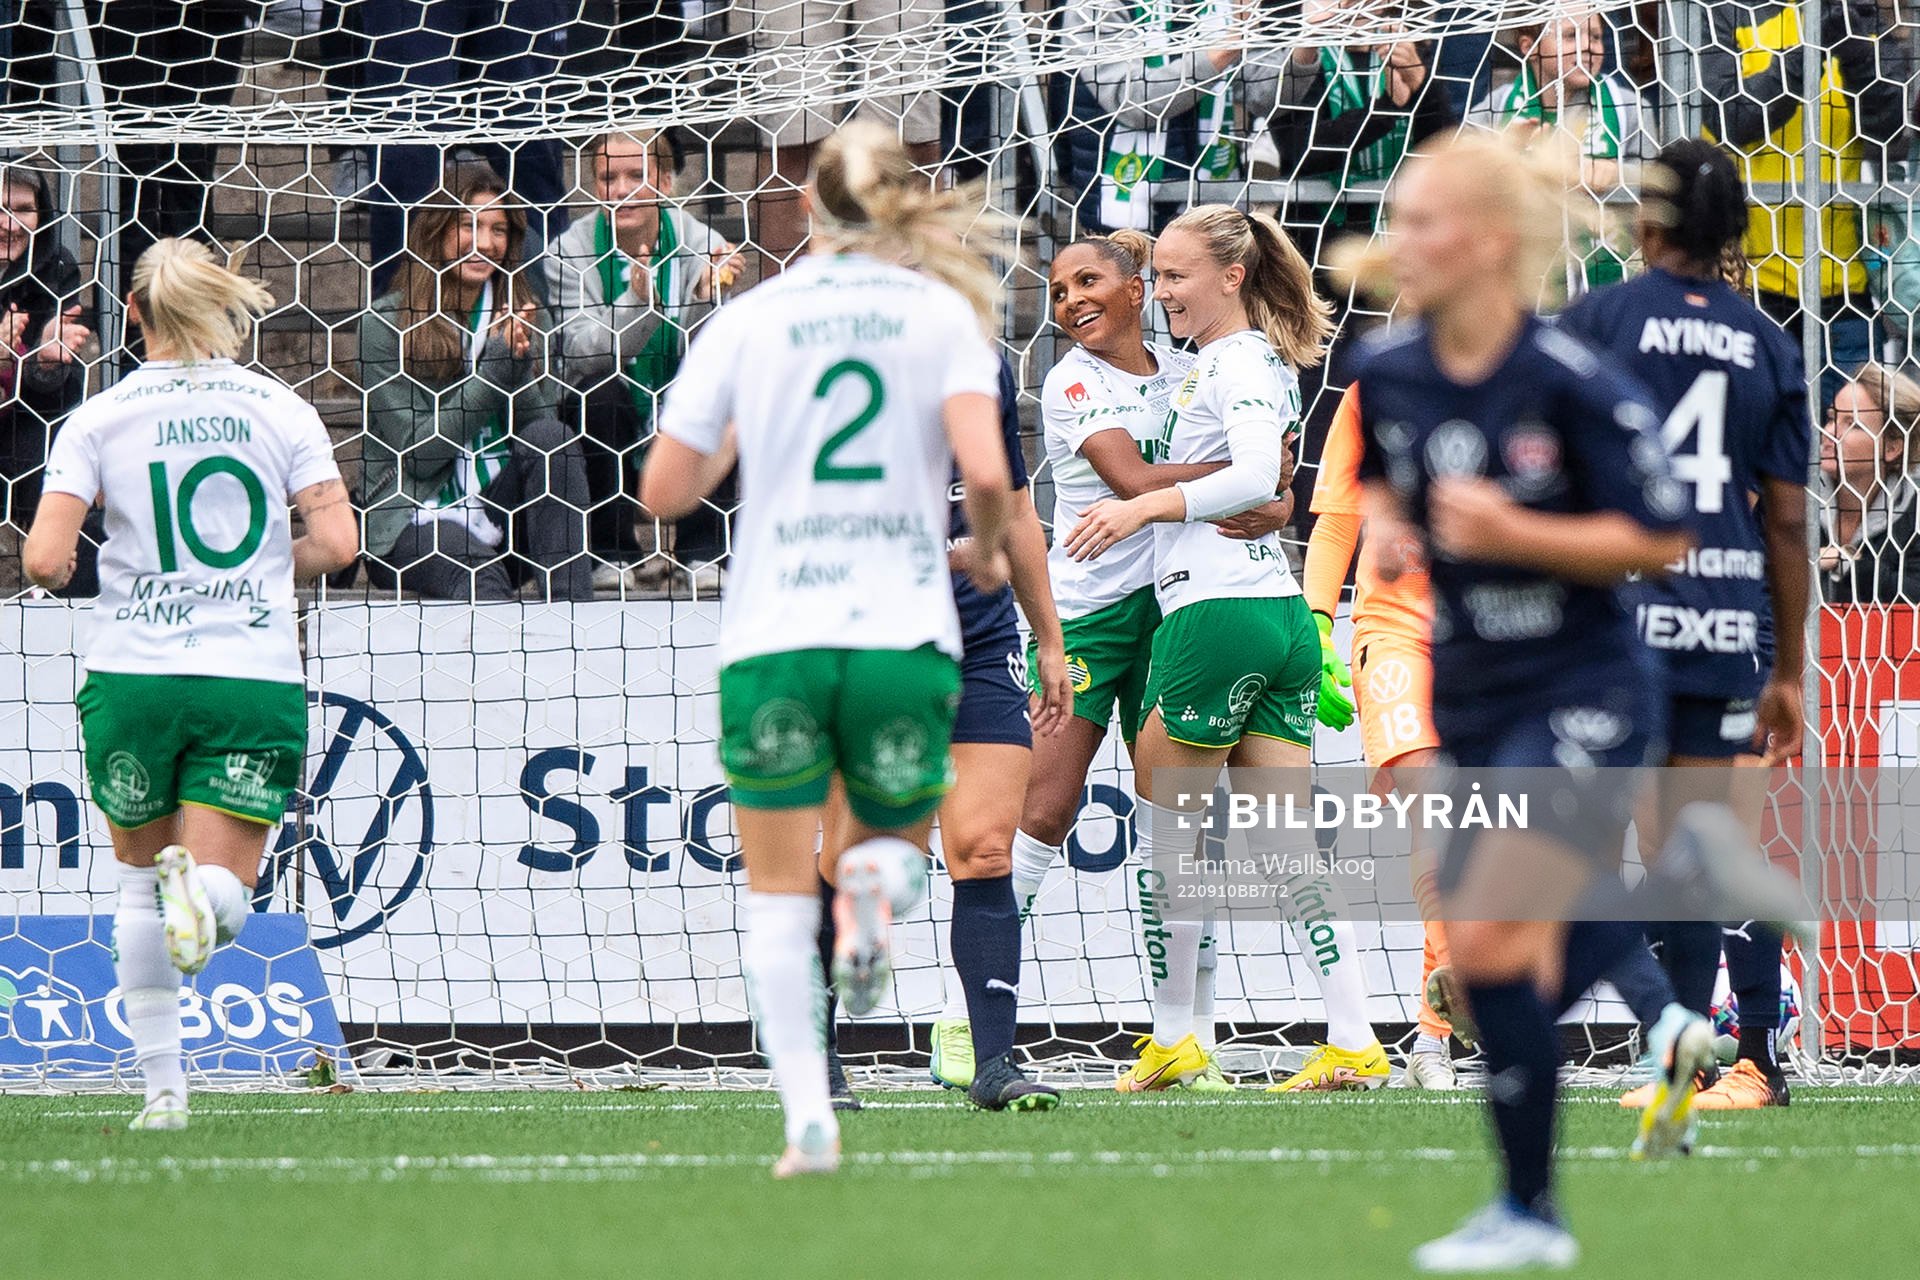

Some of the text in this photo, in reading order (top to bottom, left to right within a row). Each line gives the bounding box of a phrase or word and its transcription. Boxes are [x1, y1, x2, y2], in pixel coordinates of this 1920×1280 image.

[1638, 317, 1756, 369] AYINDE
[155, 416, 252, 447] JANSSON
[813, 359, 885, 482] 2
[1660, 370, 1732, 514] 4
[148, 454, 268, 573] 10
[1664, 546, 1765, 580] igma
[1380, 703, 1421, 749] 18
